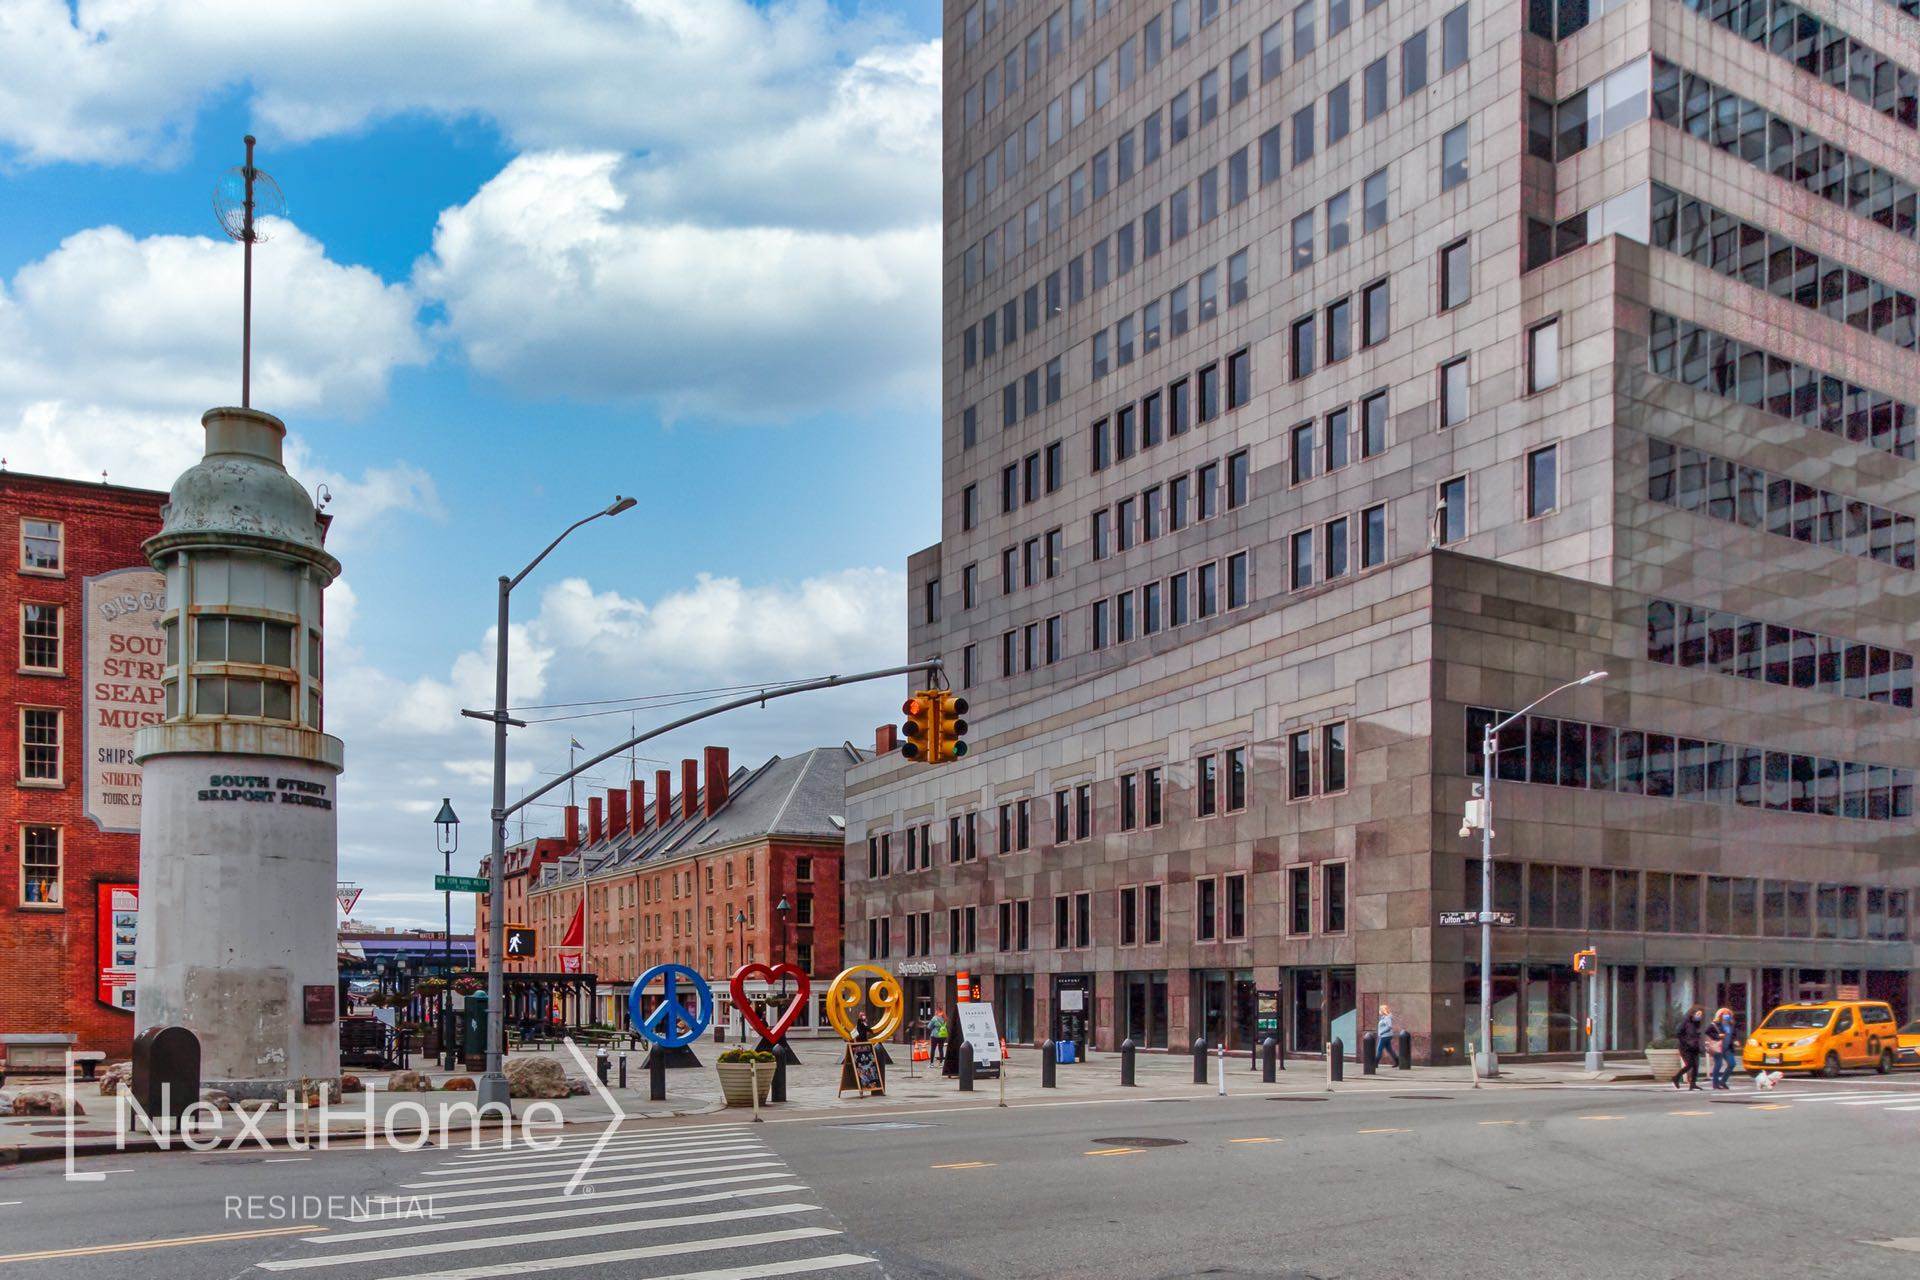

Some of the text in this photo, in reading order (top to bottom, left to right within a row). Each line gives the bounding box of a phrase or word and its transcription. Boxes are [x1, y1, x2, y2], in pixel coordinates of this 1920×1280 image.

[110, 633, 166, 656] SOU
[98, 747, 134, 764] SHIPS
[210, 774, 326, 796] SOUTH STREET
[198, 789, 275, 802] SEAPORT
[1440, 915, 1461, 924] Fulton
